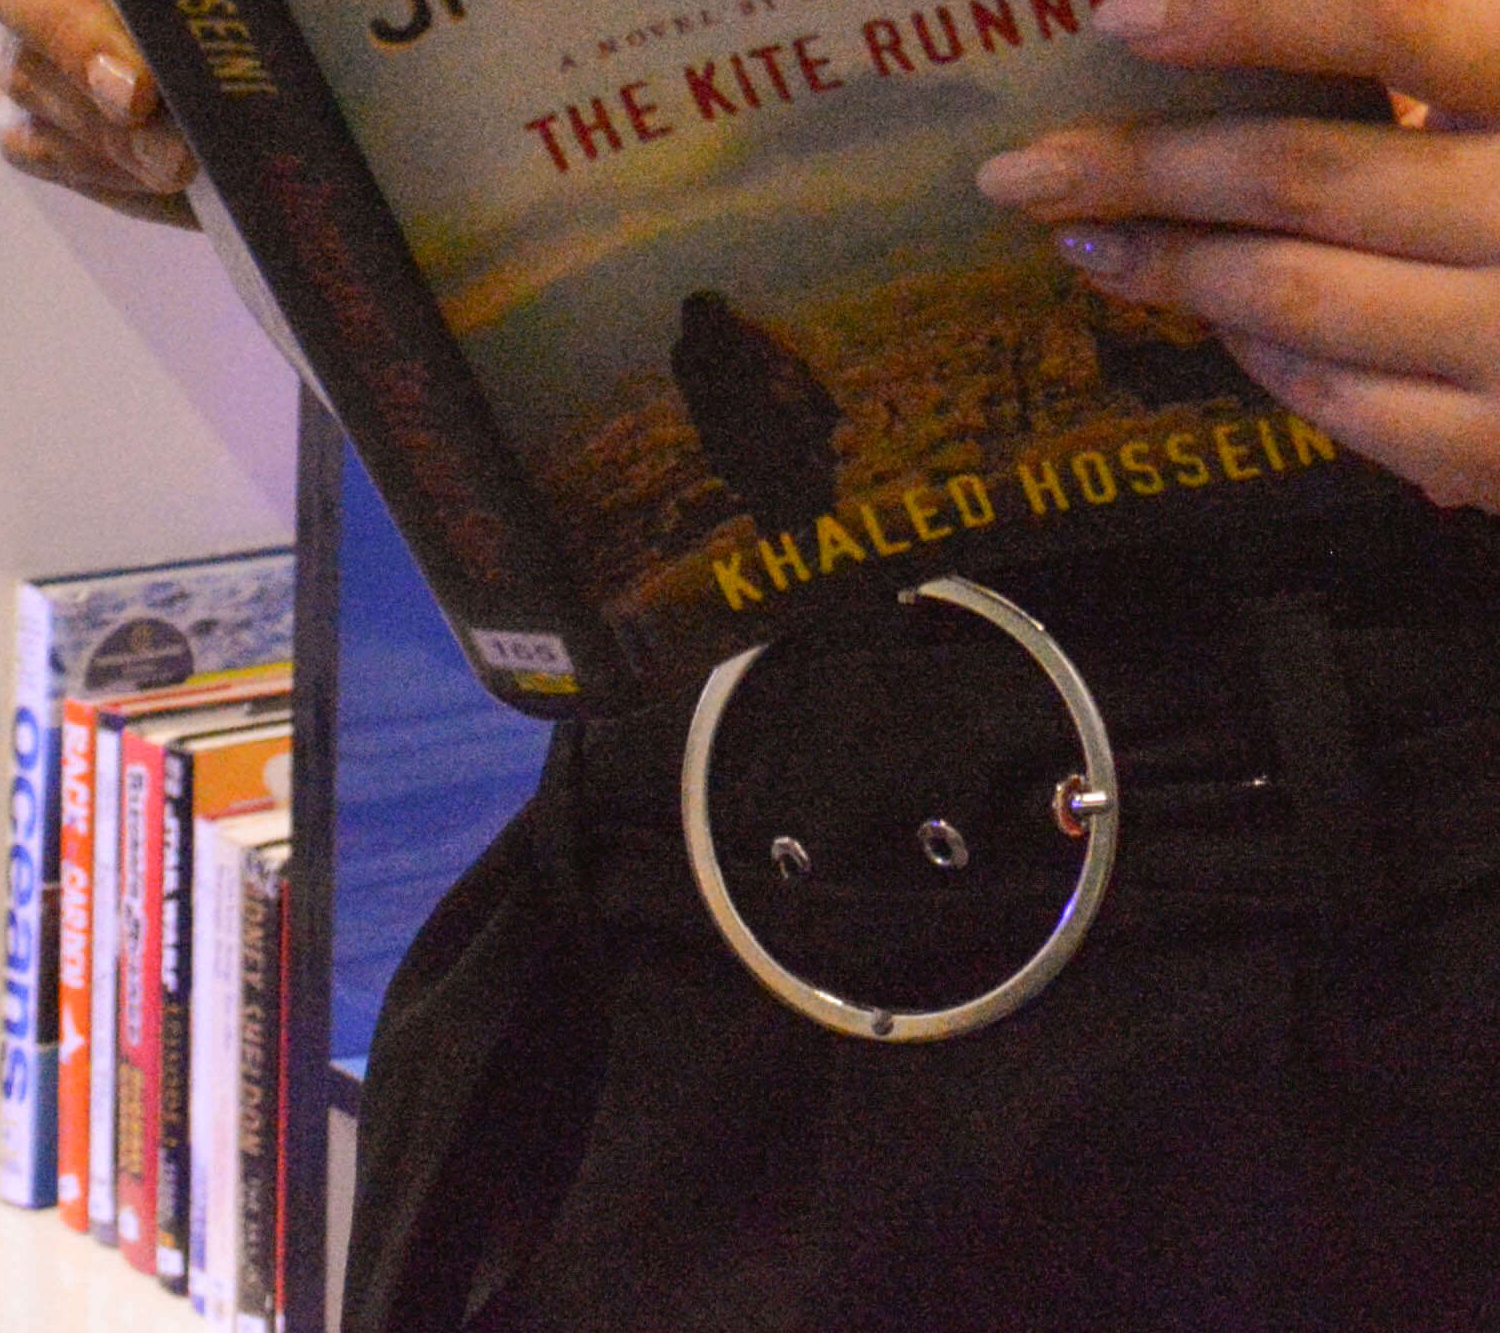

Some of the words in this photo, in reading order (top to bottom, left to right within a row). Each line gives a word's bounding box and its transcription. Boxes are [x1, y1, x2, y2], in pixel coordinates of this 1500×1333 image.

[524, 81, 673, 174] THE
[685, 32, 846, 122] KITE
[594, 8, 716, 59] NOVEL
[708, 472, 998, 613] KHALED
[2, 705, 42, 1104] oceans
